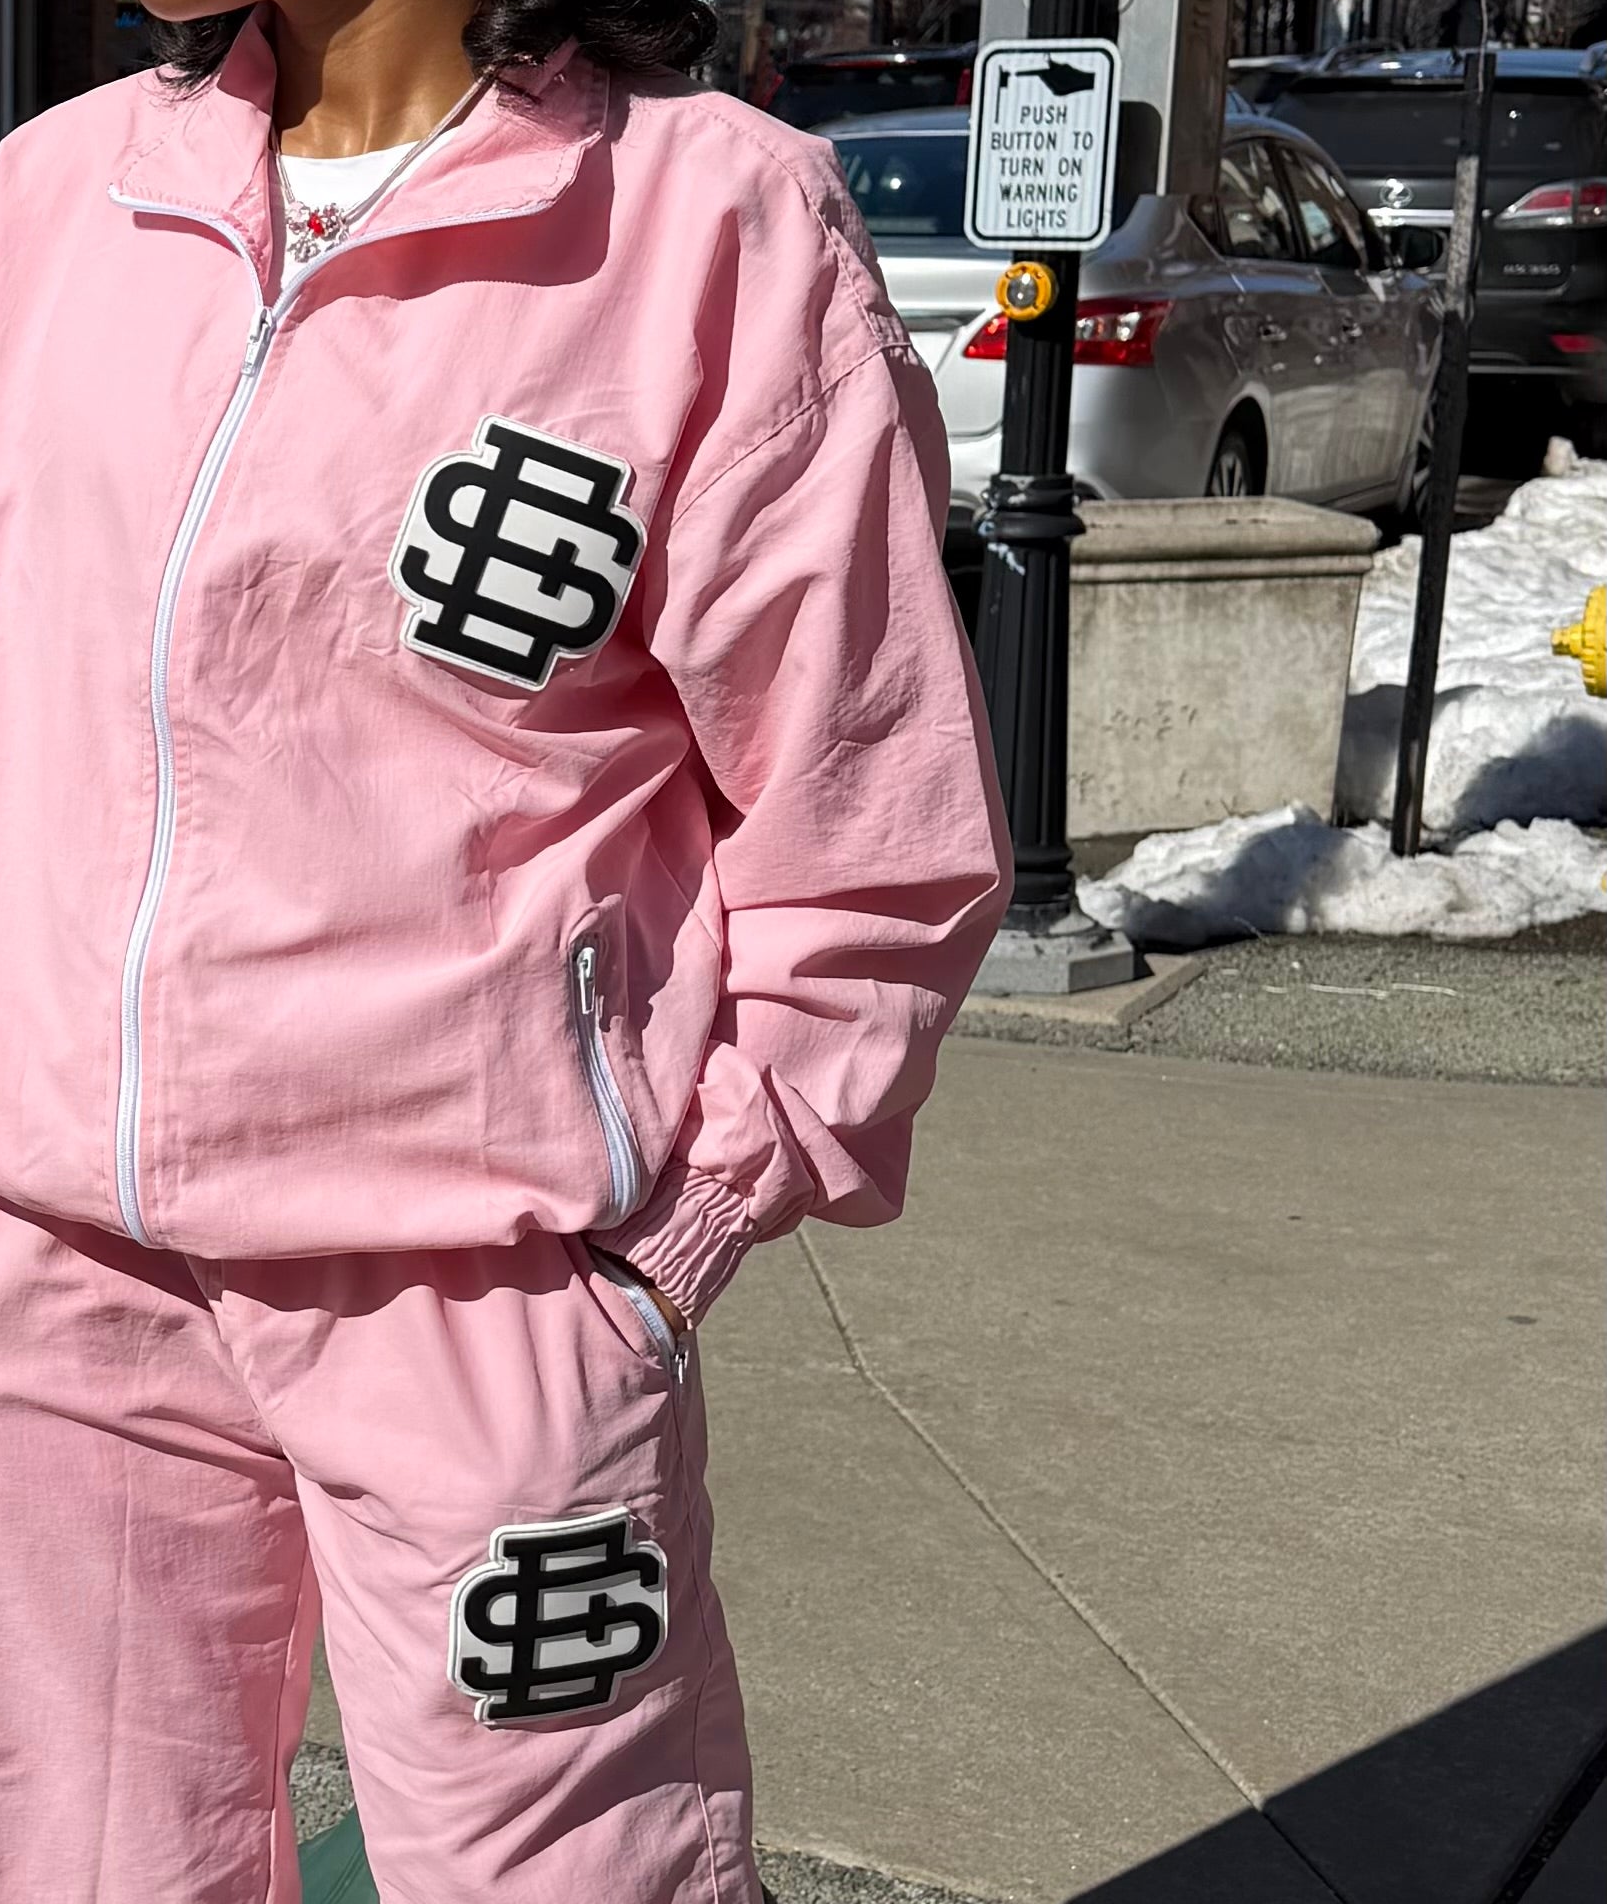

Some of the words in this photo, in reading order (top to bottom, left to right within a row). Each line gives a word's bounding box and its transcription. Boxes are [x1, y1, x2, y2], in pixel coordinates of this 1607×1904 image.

[1019, 105, 1067, 124] PUSH
[991, 131, 1058, 150] BUTTON
[1074, 132, 1094, 150] TO
[999, 157, 1044, 176] TURN
[1058, 158, 1082, 176] ON
[999, 183, 1078, 203] WARNING
[1006, 209, 1067, 229] LIGHTS
